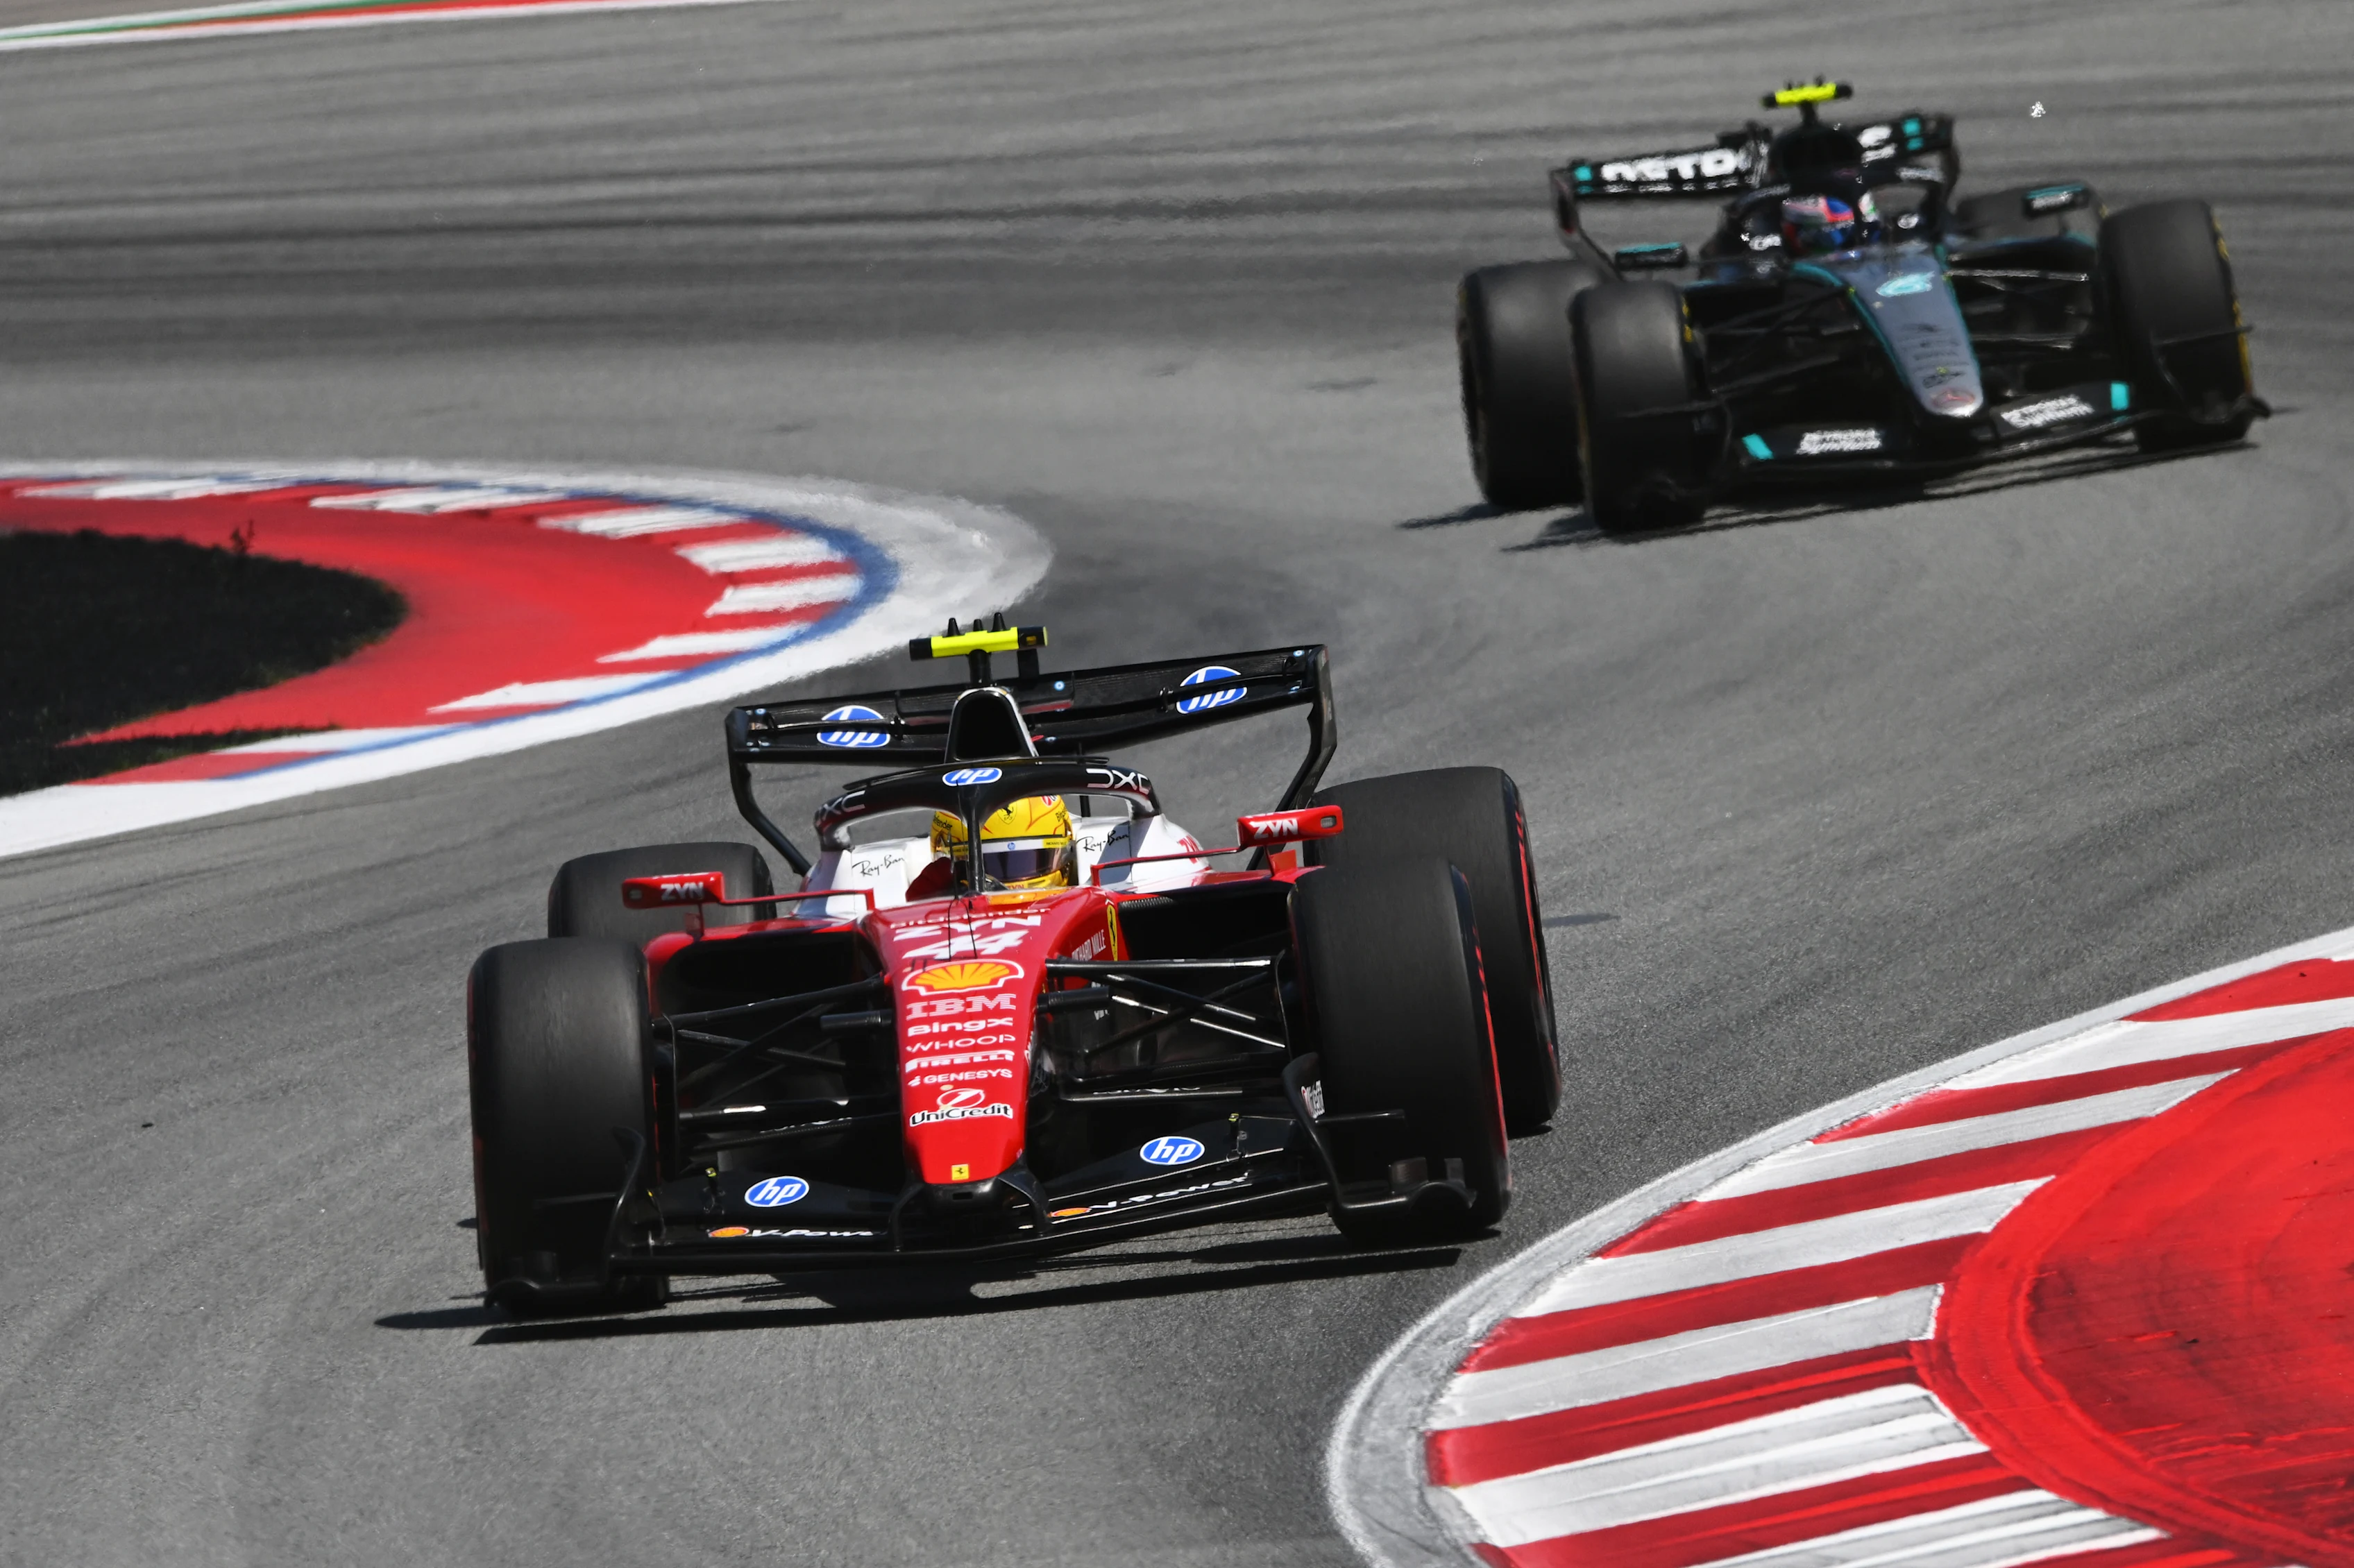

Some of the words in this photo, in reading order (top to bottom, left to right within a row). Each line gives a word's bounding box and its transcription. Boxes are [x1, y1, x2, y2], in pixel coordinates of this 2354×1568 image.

[950, 768, 997, 785] hp
[1086, 768, 1150, 795] DXC
[1076, 829, 1131, 853] Ray-Ban
[1252, 819, 1298, 840] ZYN
[852, 854, 905, 877] Ray-Ban
[661, 881, 704, 901] ZYN
[893, 915, 1041, 941] ZYN
[902, 930, 1028, 960] 44
[1091, 929, 1106, 956] MILLE
[906, 994, 1017, 1021] IBM
[906, 1034, 1016, 1053] WHOOP
[905, 1049, 1015, 1073] PIRELLI
[923, 1068, 1013, 1084] GENESYS
[910, 1103, 1013, 1127] UniCredit
[1148, 1136, 1198, 1165] hp
[752, 1177, 803, 1207] hp
